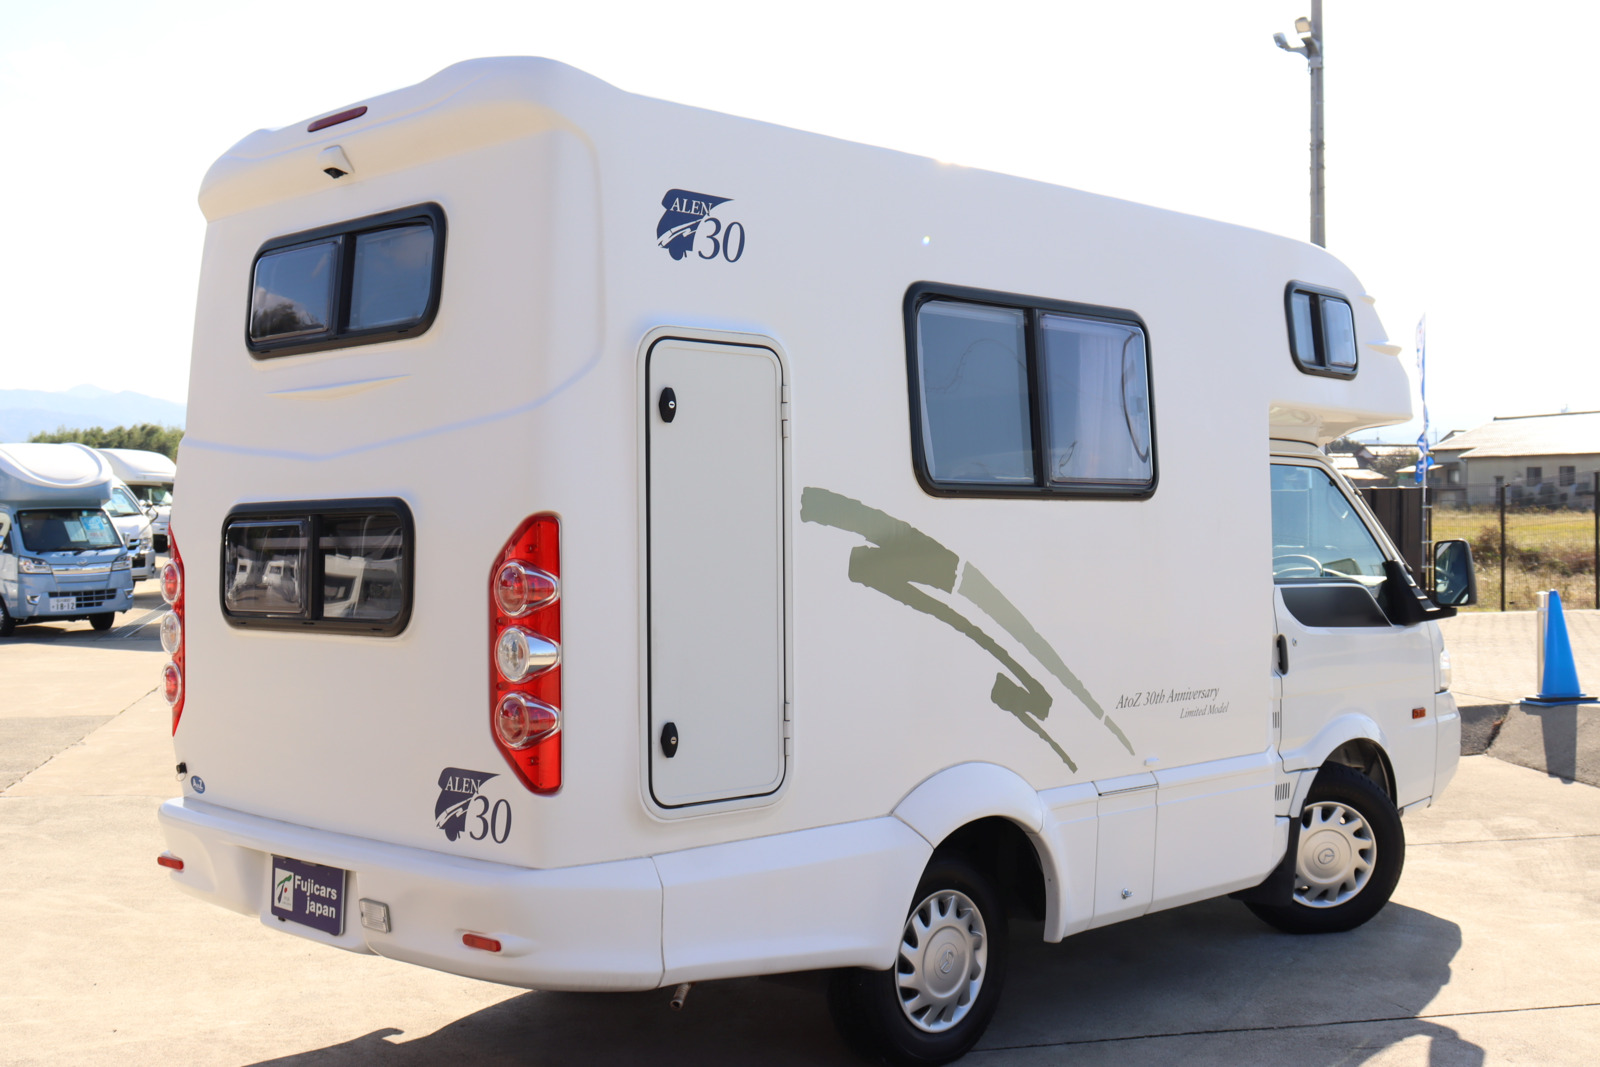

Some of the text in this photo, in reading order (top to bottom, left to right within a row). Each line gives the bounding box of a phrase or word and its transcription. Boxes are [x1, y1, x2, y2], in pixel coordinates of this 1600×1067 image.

[670, 197, 713, 217] ALEN
[698, 217, 745, 263] 30
[1115, 687, 1220, 710] AtoZ 30th Anniversary
[1179, 701, 1230, 719] Limited Model
[445, 776, 481, 795] ALEN
[469, 795, 512, 844] 30
[294, 875, 337, 900] Fujicars
[305, 897, 336, 919] japan
